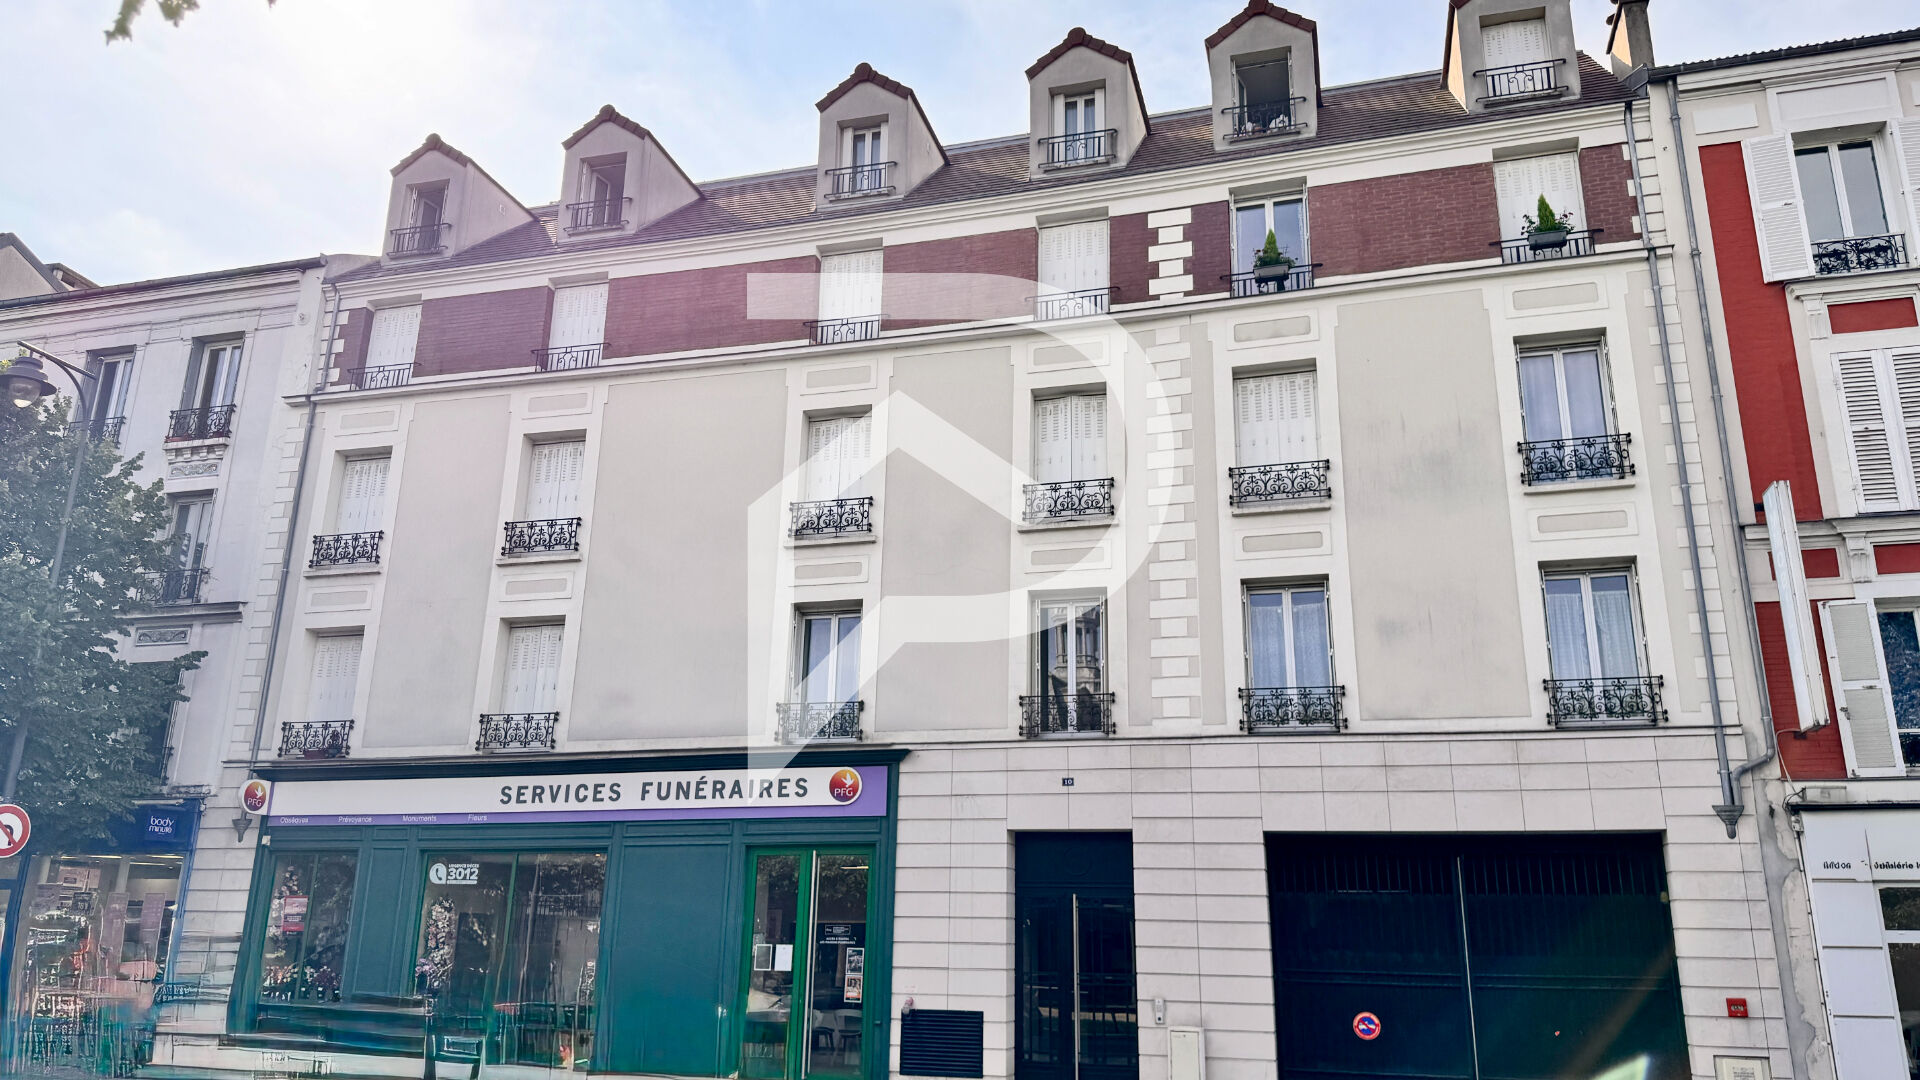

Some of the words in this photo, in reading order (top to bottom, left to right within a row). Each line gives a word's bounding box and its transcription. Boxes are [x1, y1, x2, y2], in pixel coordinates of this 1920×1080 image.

[500, 782, 621, 805] SERVICES
[640, 775, 809, 801] FUNÉRAIRES
[834, 787, 853, 797] PFG
[247, 797, 262, 807] PFG
[150, 815, 175, 826] body
[447, 867, 479, 880] 3012
